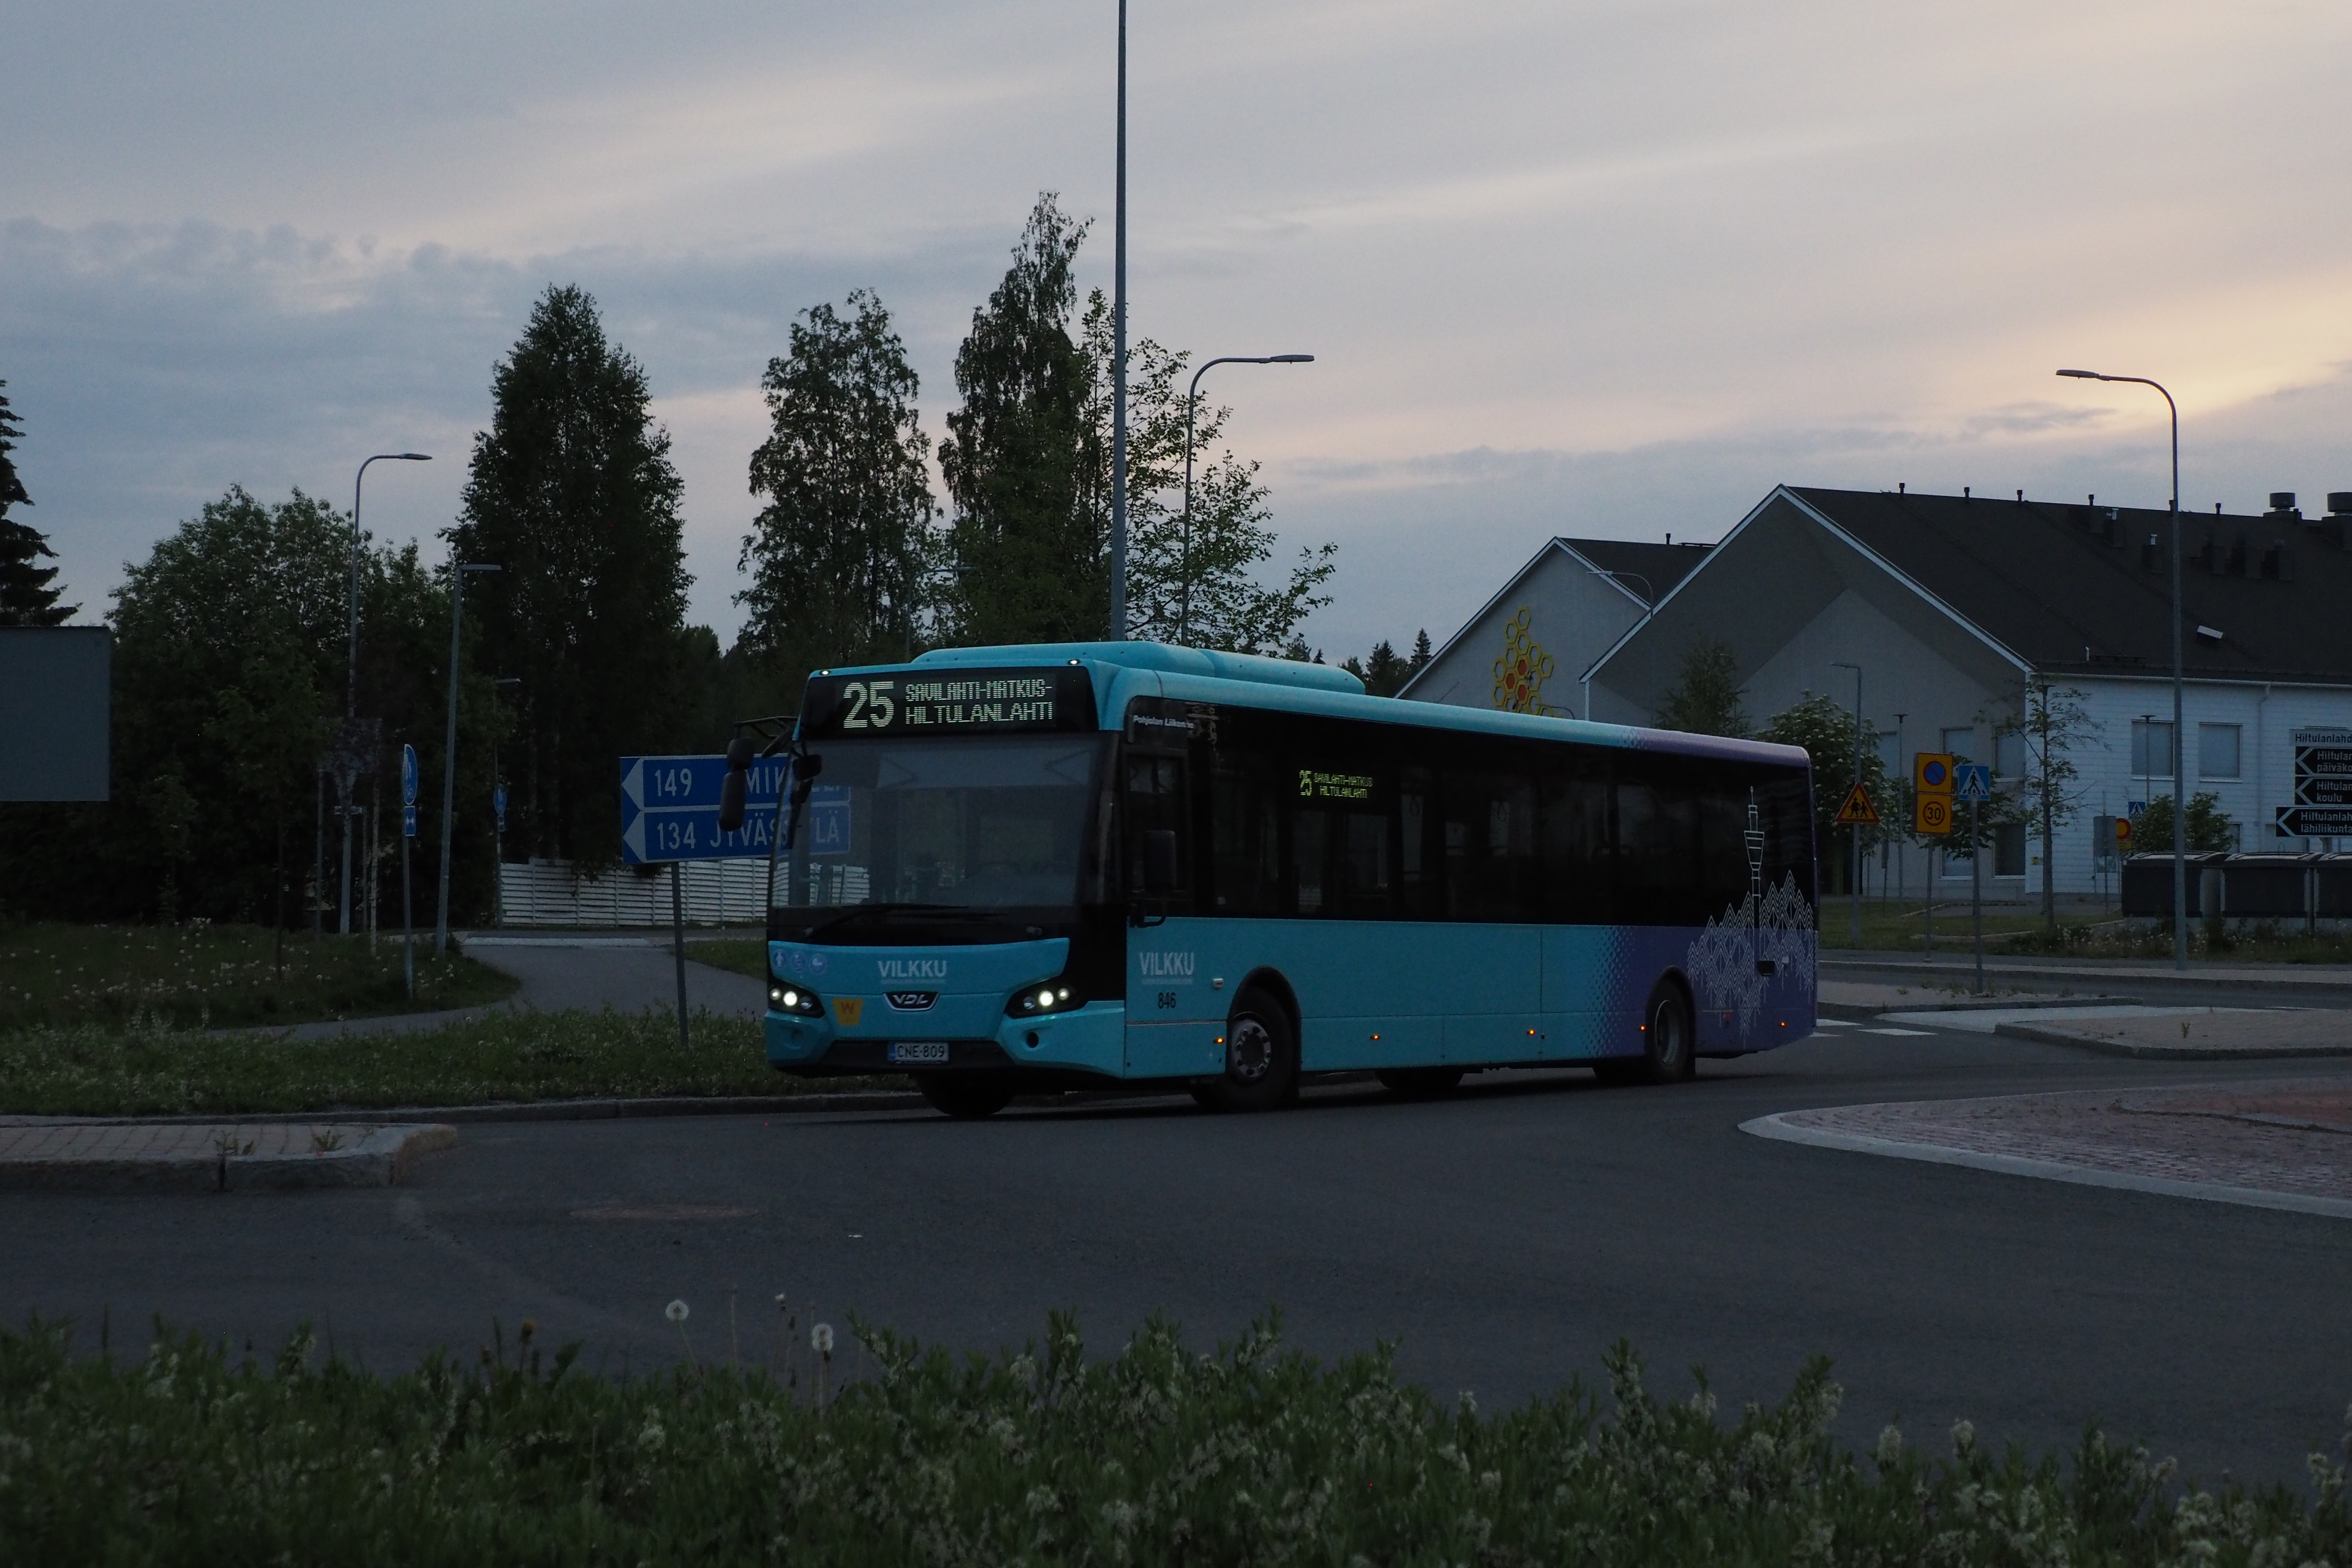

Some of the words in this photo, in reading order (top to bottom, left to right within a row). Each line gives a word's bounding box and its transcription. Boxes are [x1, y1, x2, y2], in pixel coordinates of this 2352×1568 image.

[843, 680, 895, 728] 25
[905, 702, 1053, 724] HILTULANLAHTI
[654, 768, 693, 797] 149
[2317, 793, 2342, 802] koulu
[1926, 806, 1941, 821] 30
[657, 820, 696, 850] 134
[877, 960, 947, 977] VILKKU
[1139, 952, 1194, 975] VILKKU
[893, 994, 928, 1005] VDL
[1158, 992, 1177, 1009] 846
[897, 1045, 944, 1058] CNE-809
